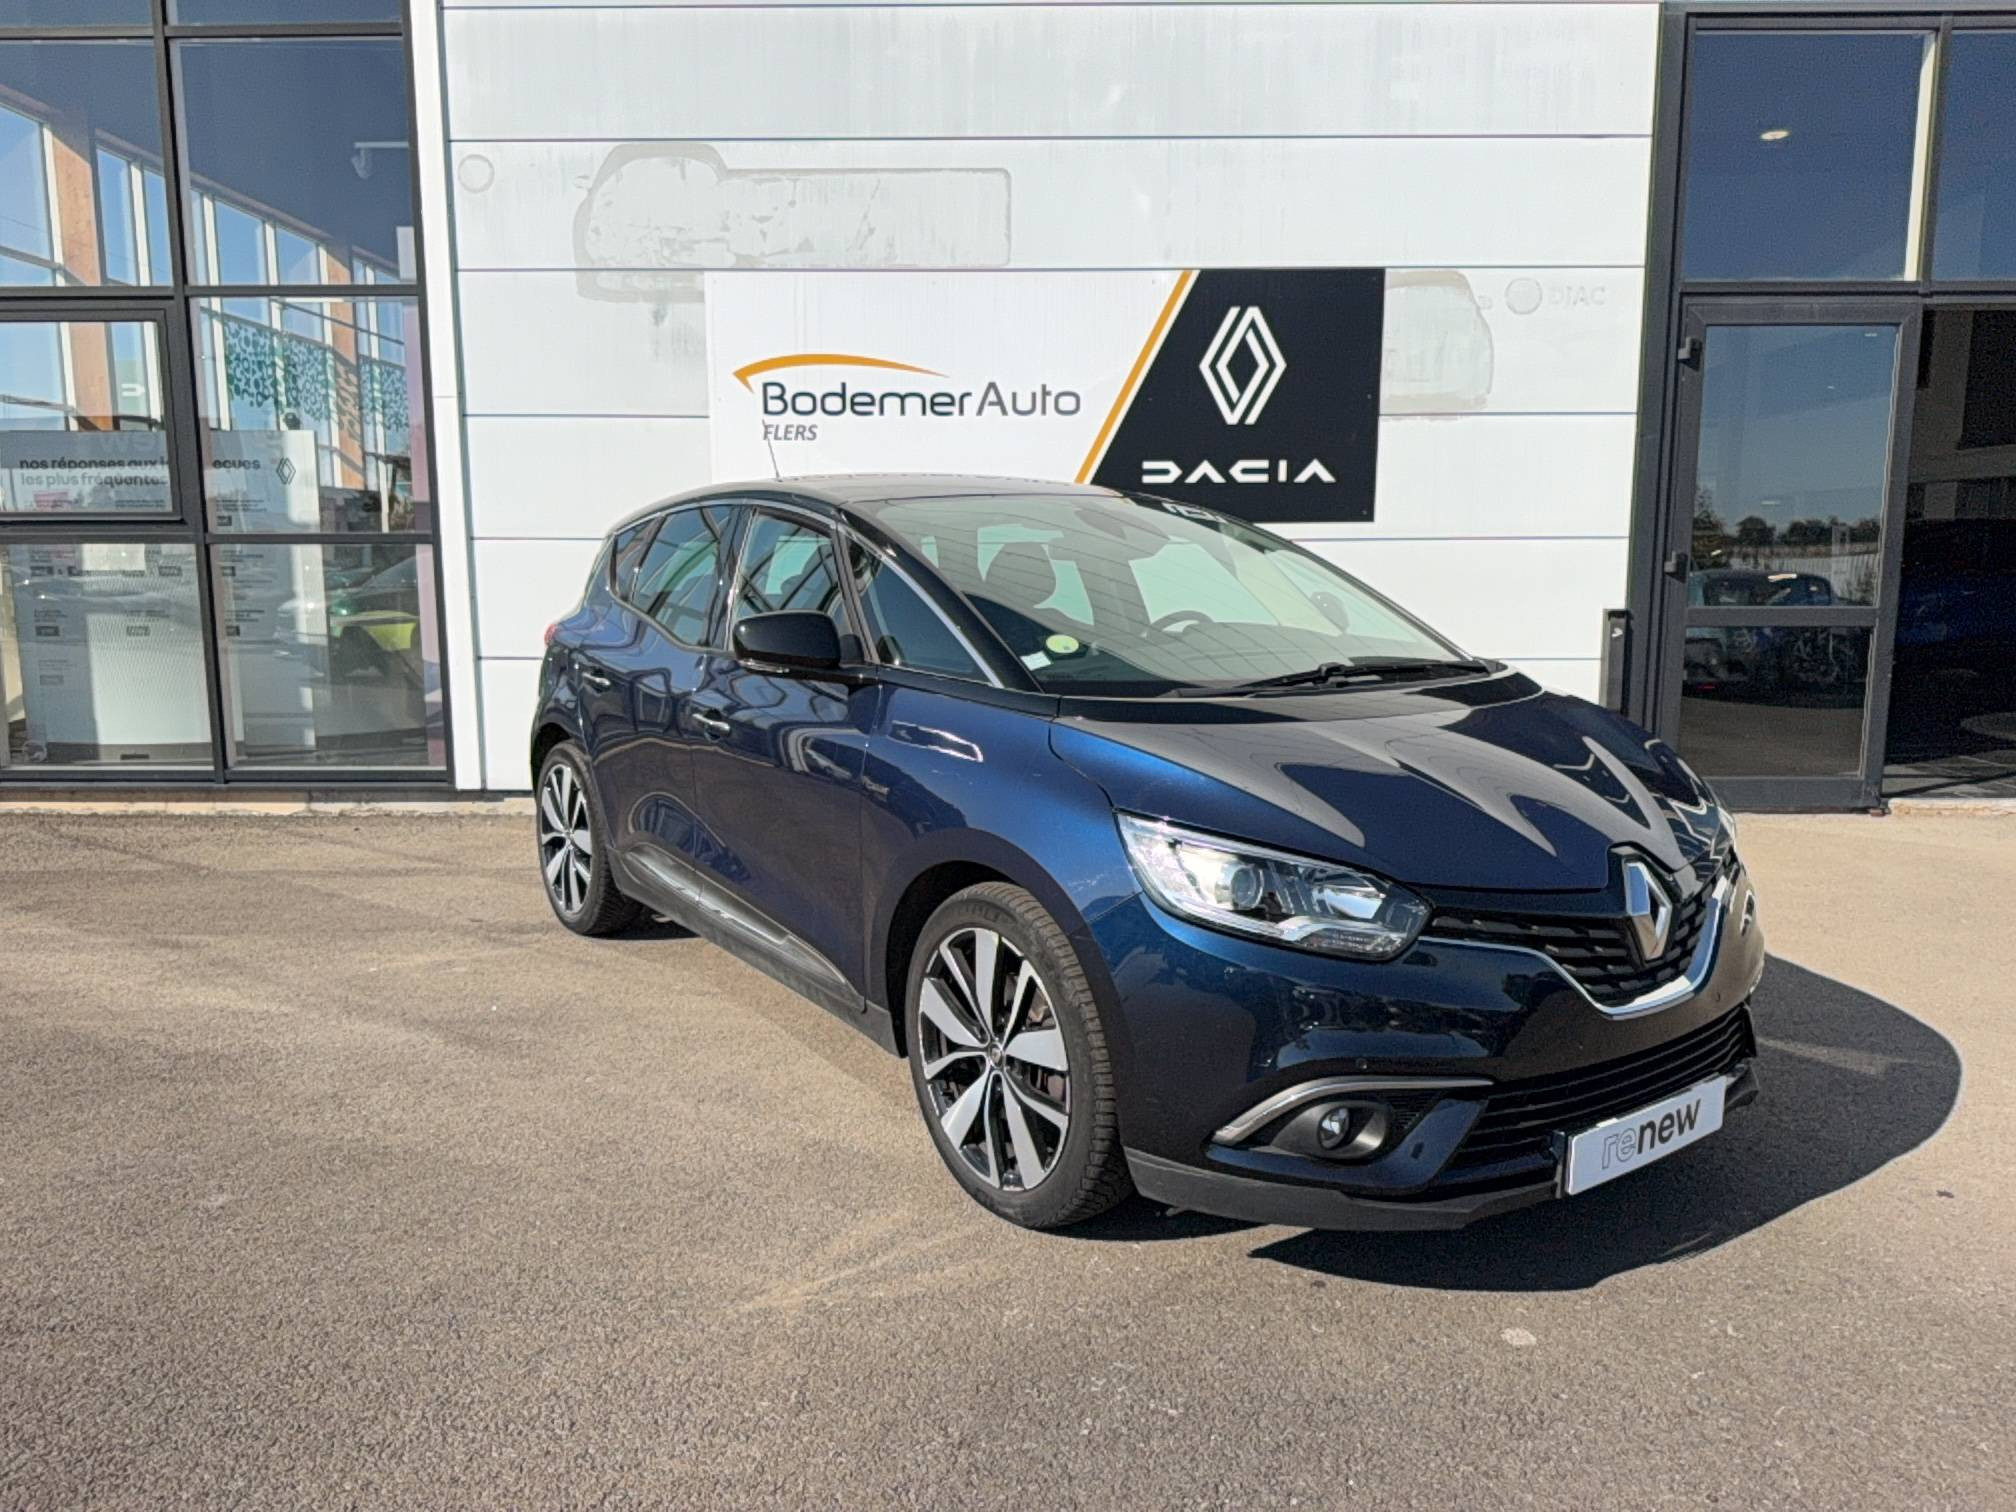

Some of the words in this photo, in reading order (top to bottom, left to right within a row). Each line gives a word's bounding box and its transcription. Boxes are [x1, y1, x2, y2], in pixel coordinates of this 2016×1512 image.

[763, 424, 818, 441] FLERS
[19, 459, 48, 470] nos
[52, 456, 125, 472] réponses
[1142, 458, 1337, 484] DACIA
[46, 472, 79, 488] plus
[1602, 1098, 1701, 1170] renew
